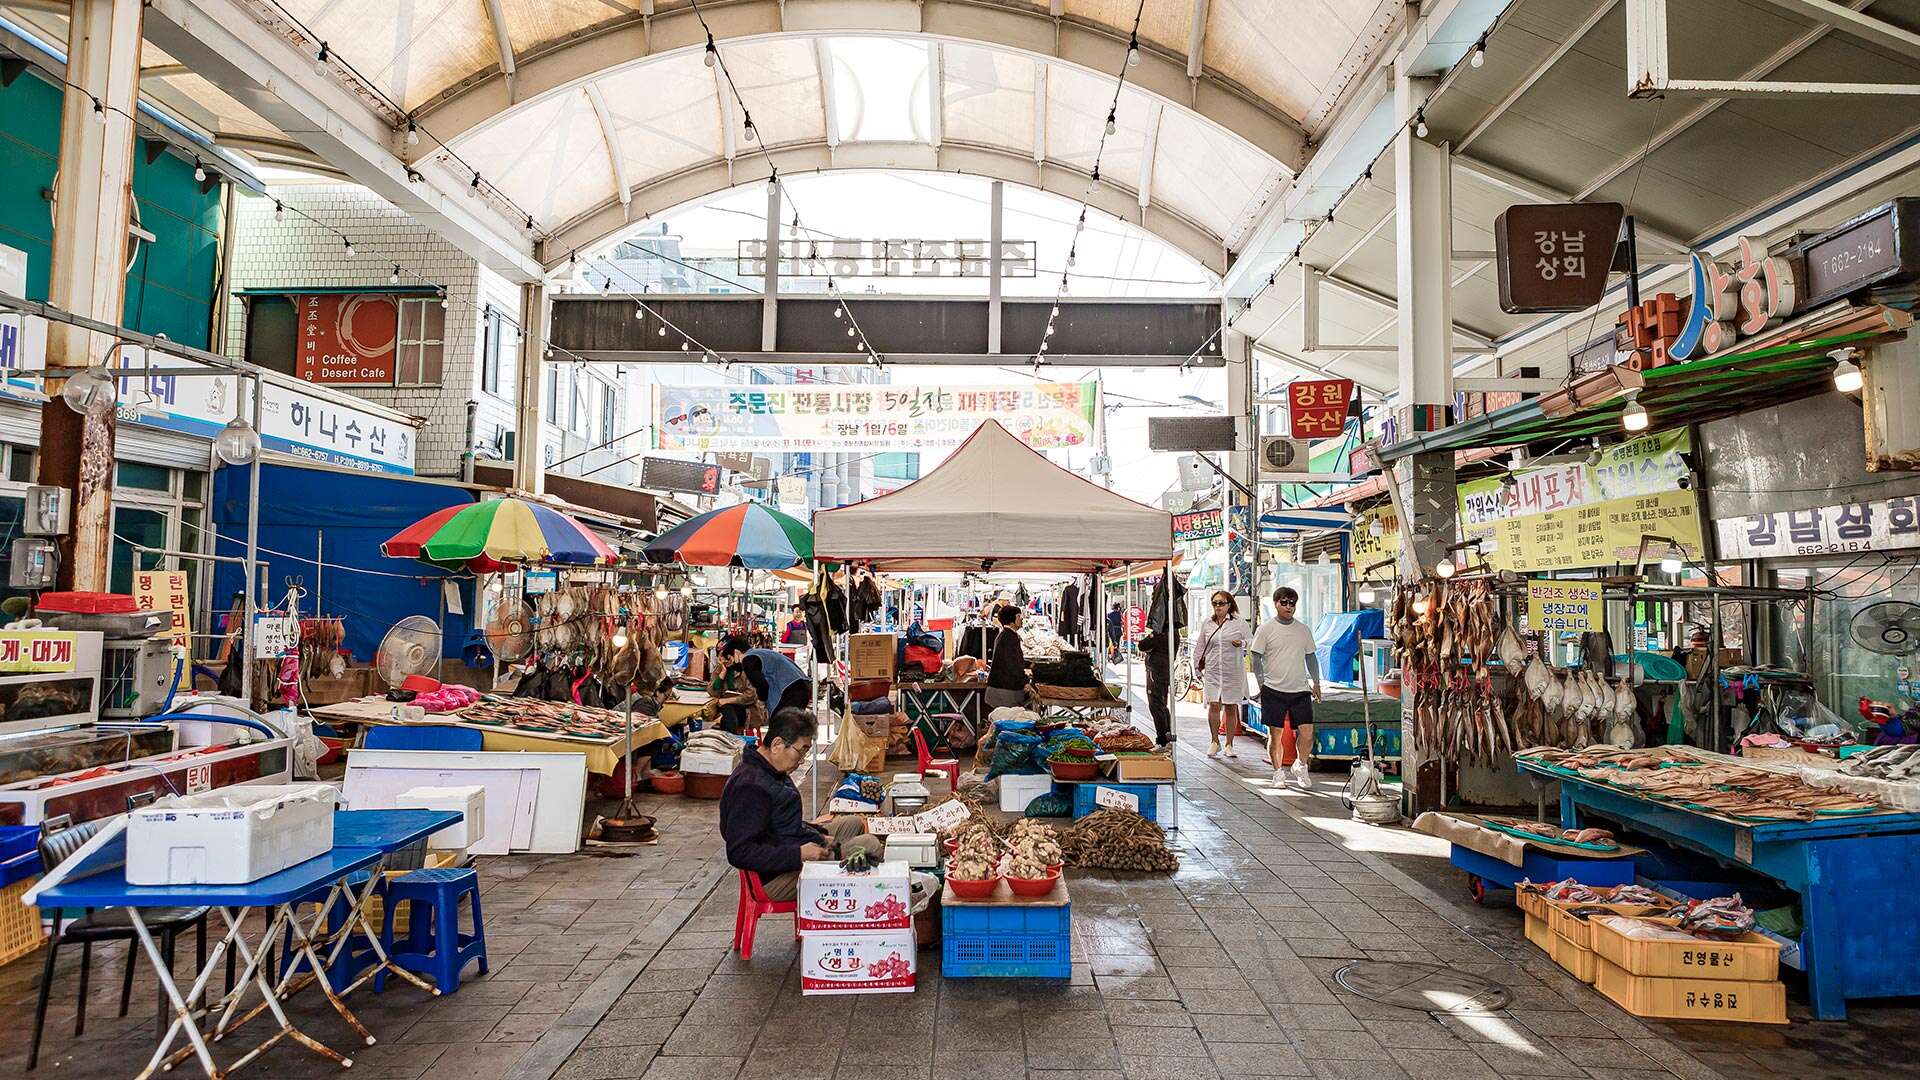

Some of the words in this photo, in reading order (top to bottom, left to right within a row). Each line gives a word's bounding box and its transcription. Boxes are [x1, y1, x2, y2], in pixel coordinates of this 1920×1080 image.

[1534, 230, 1586, 254] 강남
[1535, 255, 1586, 280] 상회
[1831, 244, 1882, 275] 662-2184
[321, 353, 358, 365] Coffee
[320, 367, 357, 378] Desert
[360, 367, 386, 378] Cafe
[1295, 383, 1344, 406] 강원
[728, 392, 786, 415] 주문진
[792, 392, 872, 415] 전통시장
[290, 401, 387, 455] 하나수산
[1296, 410, 1343, 433] 수산
[837, 423, 860, 437] 장날
[1642, 438, 1661, 453] 2호점
[1507, 465, 1584, 517] 실내포차
[1173, 509, 1221, 533] 사랑왕순대
[1797, 541, 1872, 555] 662-2184
[1531, 586, 1564, 600] 반건조
[1567, 586, 1598, 600] 생선은
[1542, 602, 1588, 616] 냉장고에
[1542, 616, 1593, 631] 있습니다.
[189, 765, 210, 788] 문어
[825, 898, 857, 910] 생강
[829, 957, 861, 969] 생강
[1683, 951, 1734, 967] 진영물산
